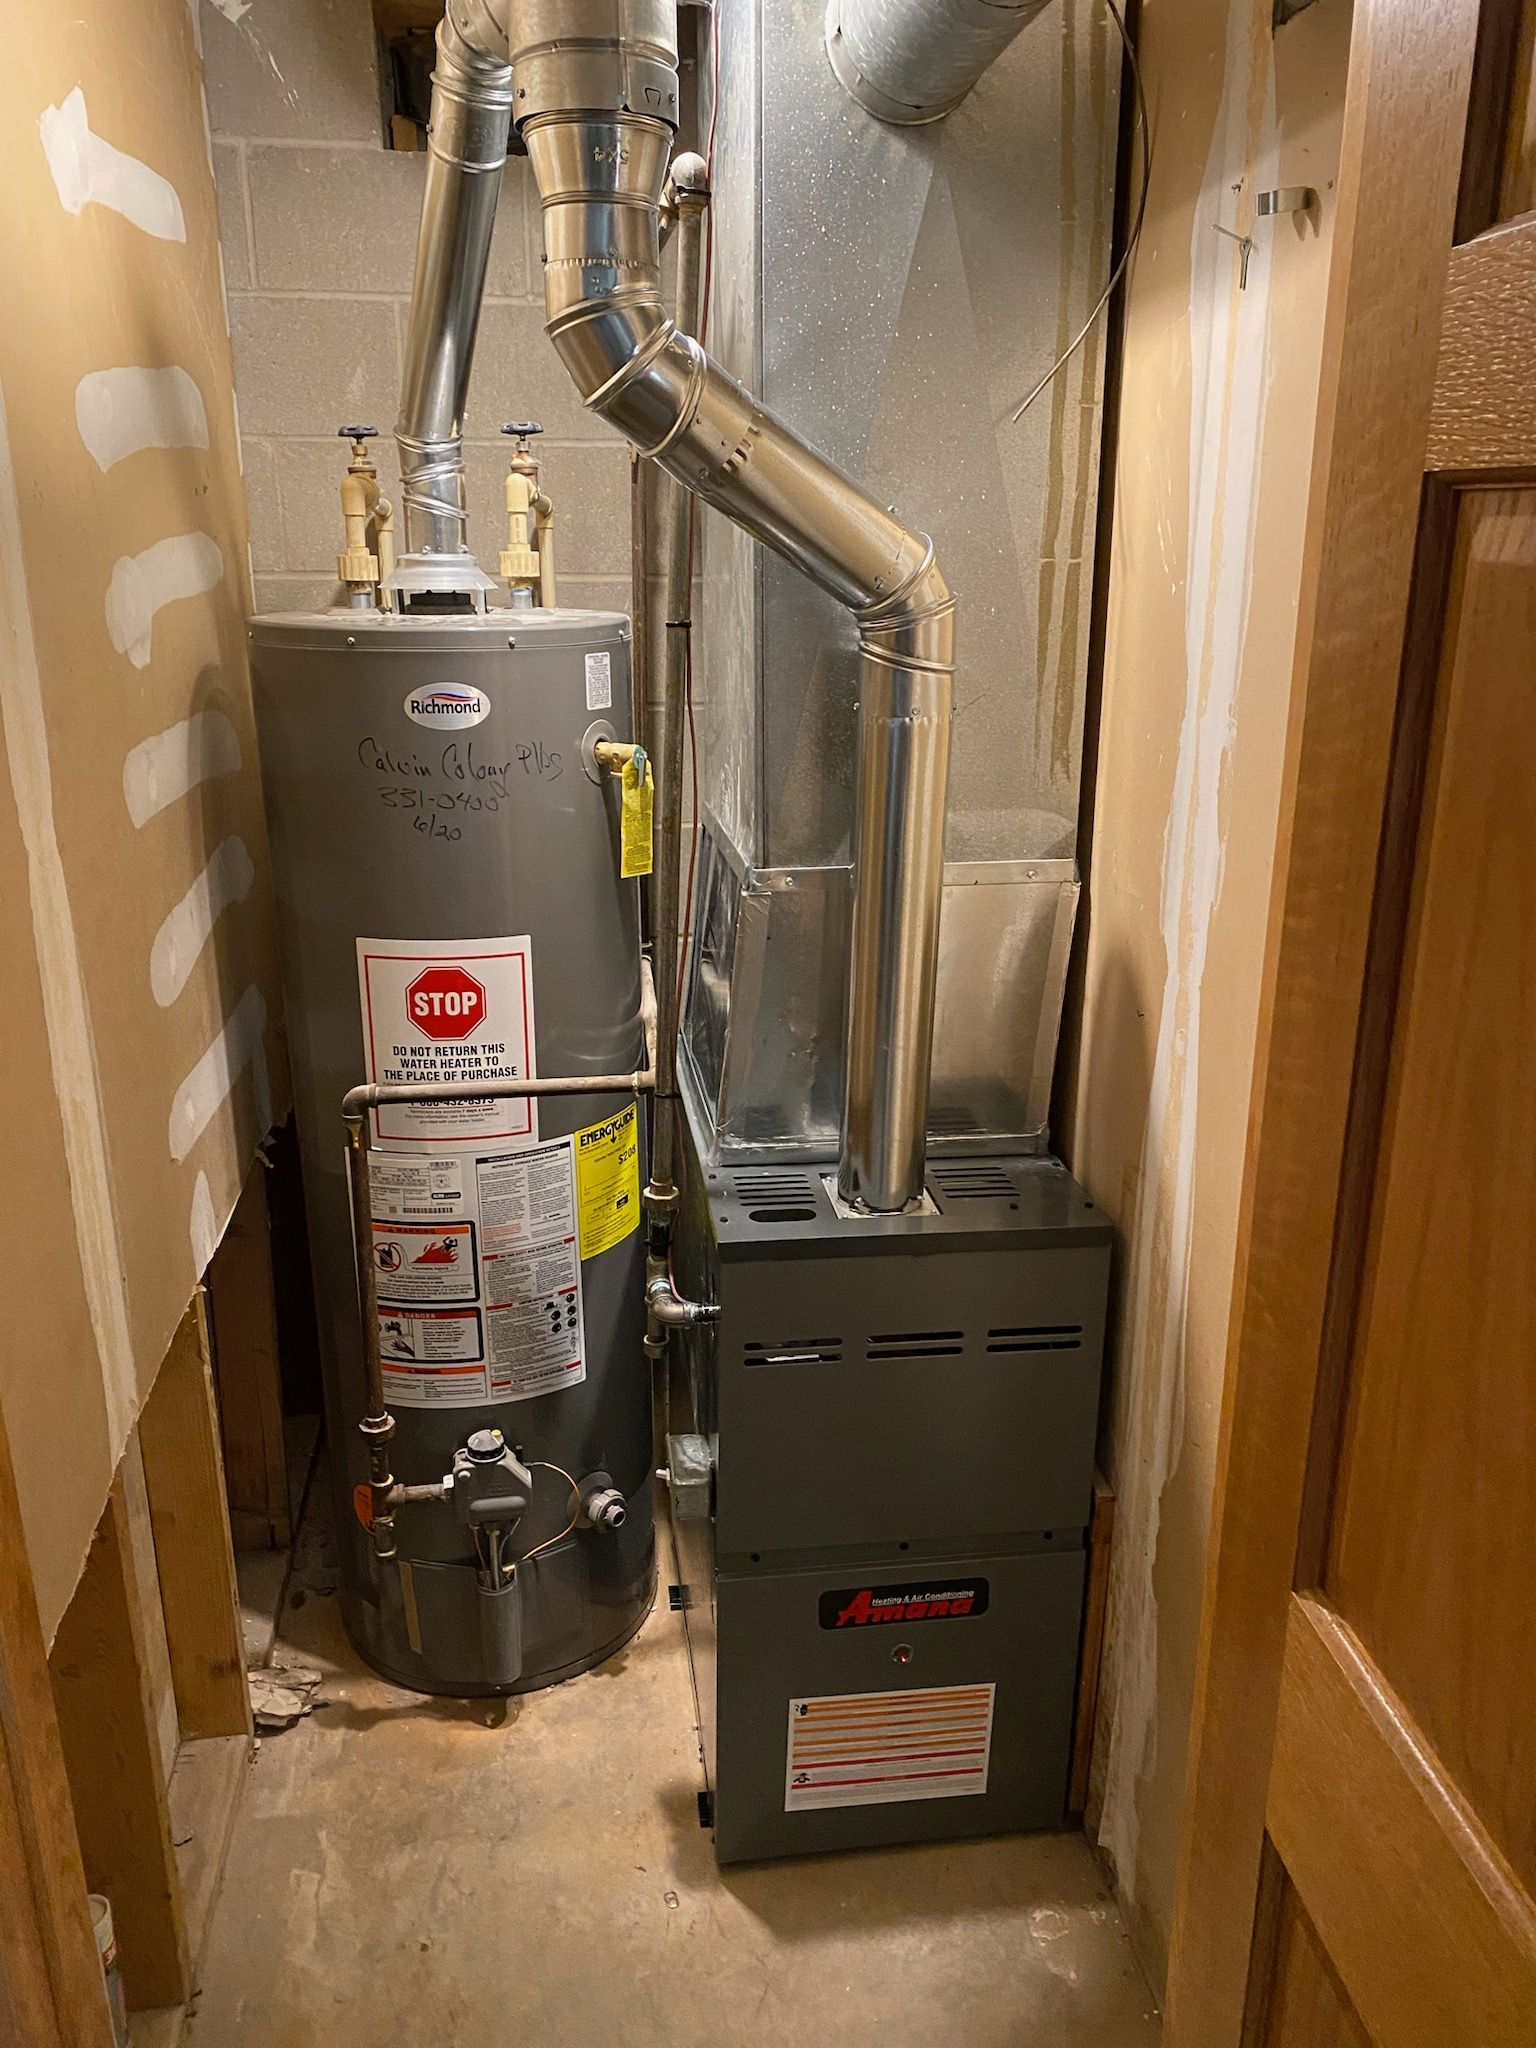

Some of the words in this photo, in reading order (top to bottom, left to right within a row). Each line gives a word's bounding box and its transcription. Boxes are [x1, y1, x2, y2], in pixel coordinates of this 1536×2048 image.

[411, 698, 481, 714] Richmond
[413, 813, 462, 841] 6/20
[414, 991, 478, 1017] STOP
[393, 1046, 407, 1056] DO
[410, 1046, 431, 1057] NOT
[435, 1045, 478, 1057] RETURN
[481, 1043, 505, 1055] THIS
[400, 1058, 437, 1069] WATER
[440, 1057, 481, 1069] HEATER
[486, 1056, 499, 1067] TO
[384, 1069, 403, 1080] THE
[406, 1071, 440, 1081] PLACE
[443, 1070, 457, 1081] OF
[461, 1066, 517, 1080] PURCHASE
[872, 1596, 902, 1606] Heating
[903, 1594, 910, 1603] &
[911, 1593, 922, 1602] Air
[924, 1590, 975, 1601] Conditioning
[834, 1588, 975, 1627] Amana
